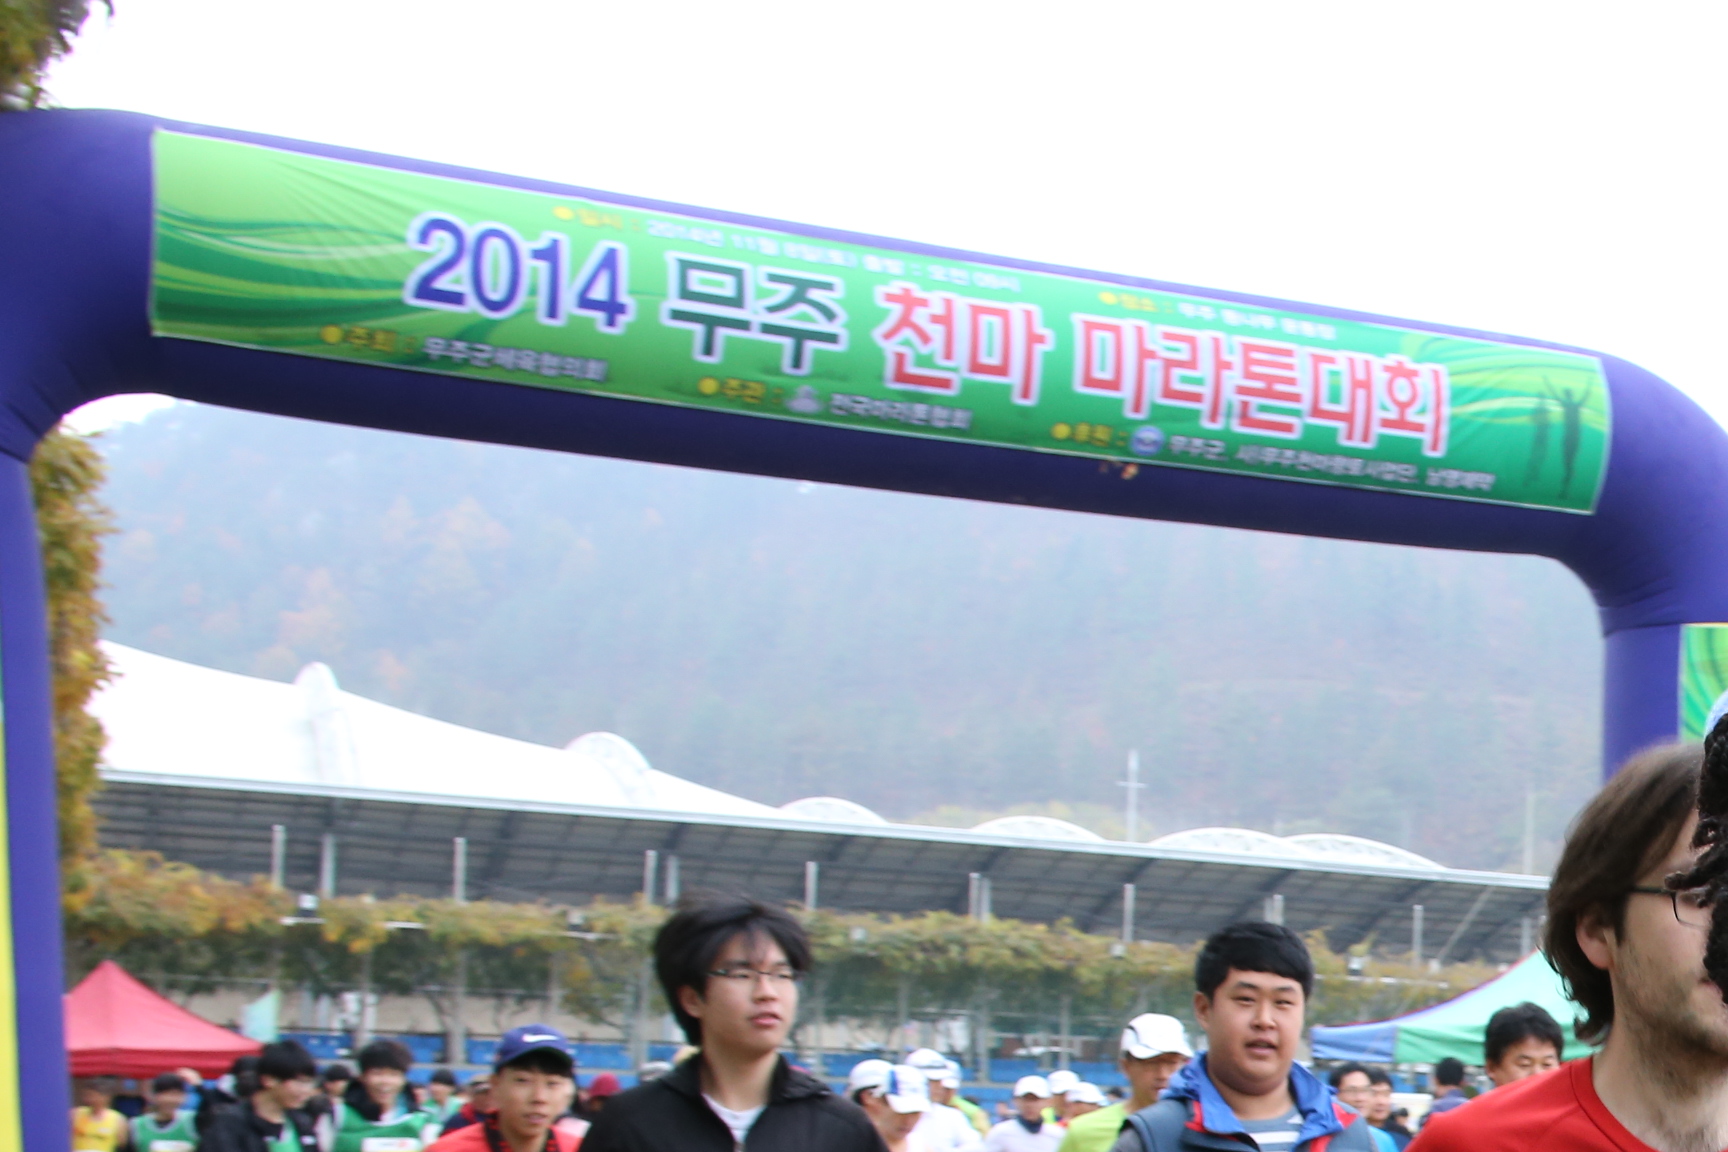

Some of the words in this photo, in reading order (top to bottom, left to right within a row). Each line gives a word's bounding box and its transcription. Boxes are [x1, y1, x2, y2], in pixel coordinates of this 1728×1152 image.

[406, 213, 632, 332] 2014
[661, 251, 848, 373] 무주
[873, 282, 1053, 404] 천마
[1071, 311, 1449, 456] 마라톤대회
